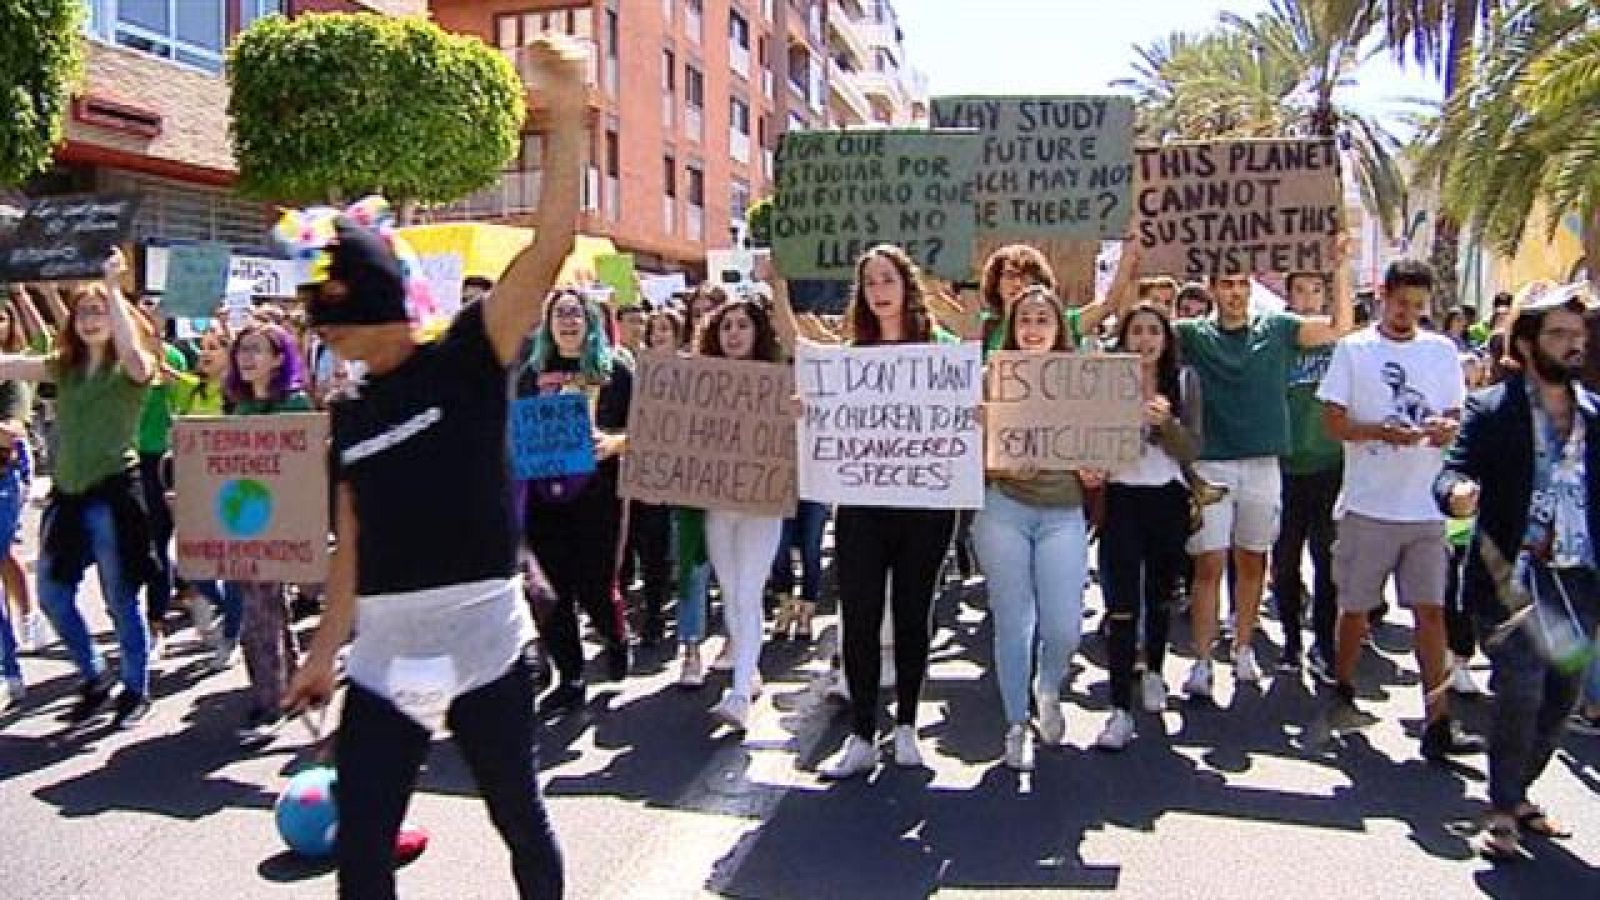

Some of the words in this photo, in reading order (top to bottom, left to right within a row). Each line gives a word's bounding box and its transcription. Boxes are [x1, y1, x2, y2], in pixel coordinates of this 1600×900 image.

[931, 100, 1000, 130] WHY
[1018, 101, 1106, 131] STUDY
[984, 136, 1097, 164] FUTURE
[1134, 145, 1216, 180] THIS
[1229, 140, 1336, 173] PLANET
[898, 156, 950, 177] POR
[976, 170, 1018, 193] ICH
[1029, 167, 1080, 191] MAY
[1139, 179, 1280, 217] CANNOT
[775, 212, 880, 237] QUIZAS
[900, 210, 945, 232] NO
[1140, 211, 1274, 247] SUSTAIN
[1279, 206, 1338, 235] THIS
[1186, 241, 1321, 274] SYSTEM
[805, 360, 839, 396] I
[841, 356, 922, 393] DON'T
[927, 355, 975, 390] WANT
[635, 407, 680, 442] NO
[835, 402, 920, 432] CHILDREN
[927, 405, 950, 431] TO
[813, 437, 967, 460] ENDANGERED
[837, 462, 951, 490] SPECIES
